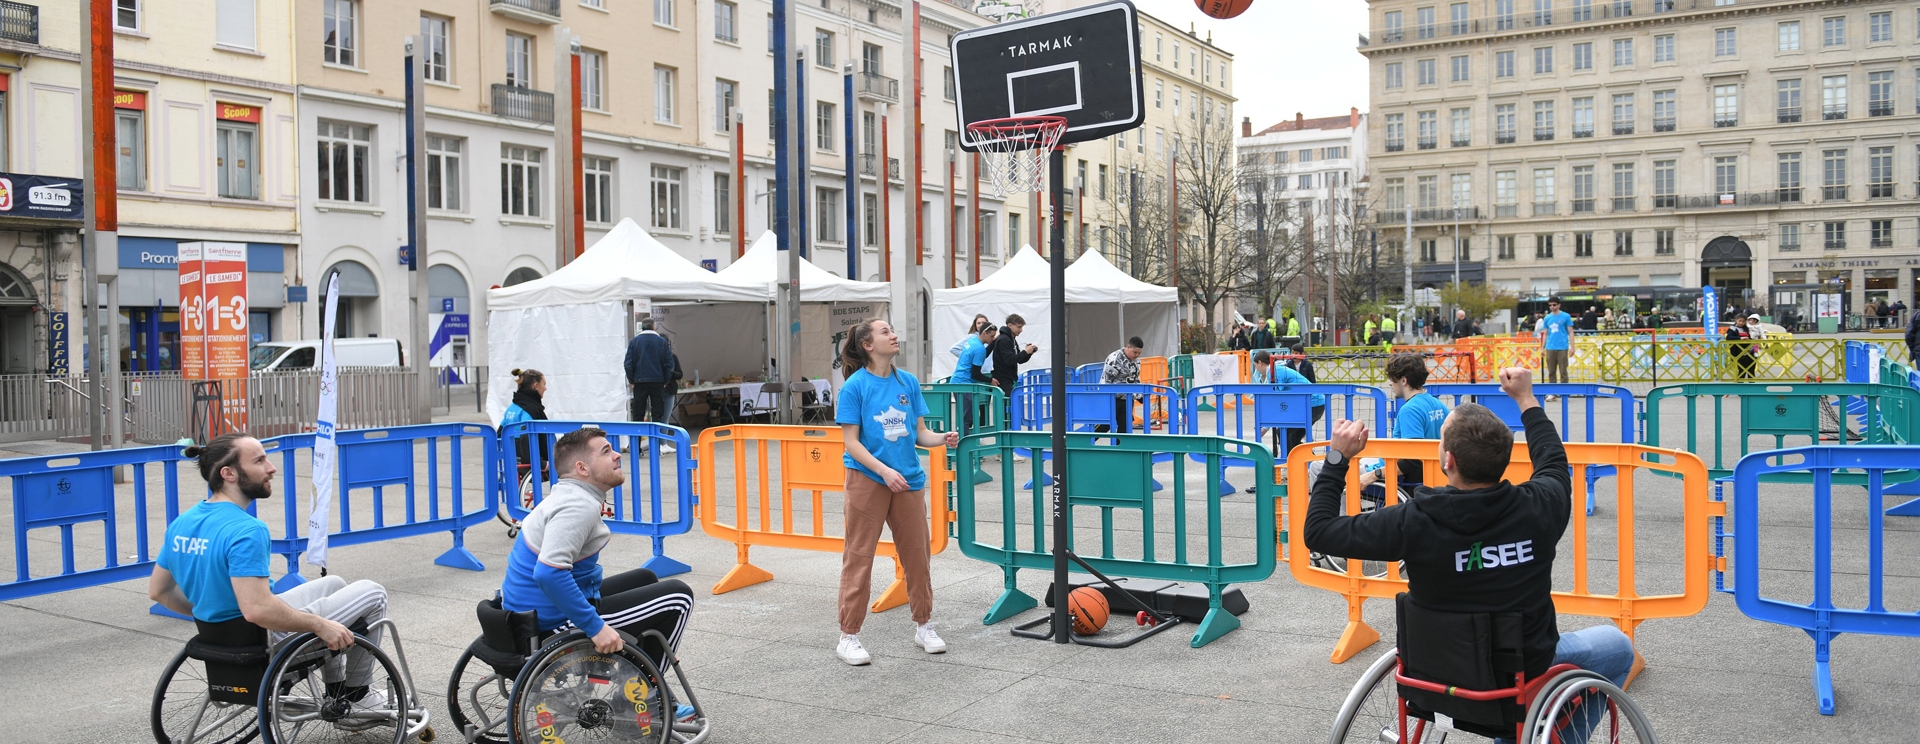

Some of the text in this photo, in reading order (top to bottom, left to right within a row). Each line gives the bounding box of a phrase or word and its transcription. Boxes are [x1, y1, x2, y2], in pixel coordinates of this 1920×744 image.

[1008, 35, 1073, 57] TARMAK
[223, 107, 250, 118] Scoop
[34, 192, 66, 201] 91.3 fm
[207, 295, 246, 331] 1=3
[833, 306, 870, 316] BDE STAPS
[52, 313, 67, 376] COIFFUR
[883, 418, 904, 426] JNSH
[172, 535, 209, 556] STAFF
[211, 684, 249, 694] RYDER
